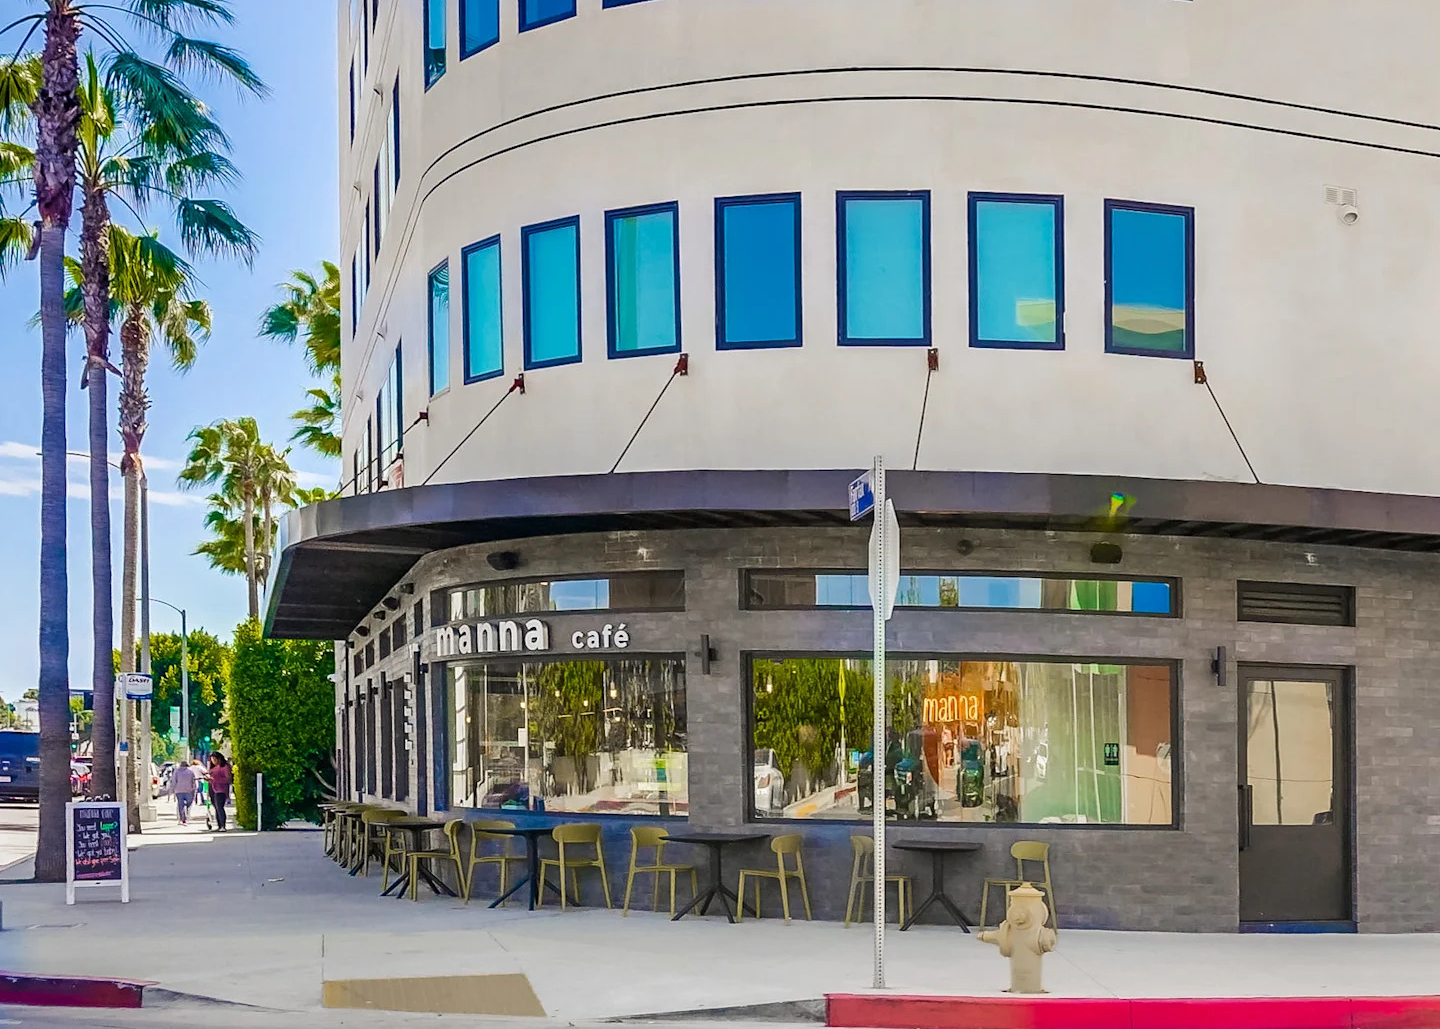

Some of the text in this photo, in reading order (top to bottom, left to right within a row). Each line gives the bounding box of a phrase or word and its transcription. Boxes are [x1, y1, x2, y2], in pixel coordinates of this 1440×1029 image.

[436, 618, 630, 657] manna café
[923, 695, 978, 723] manna
